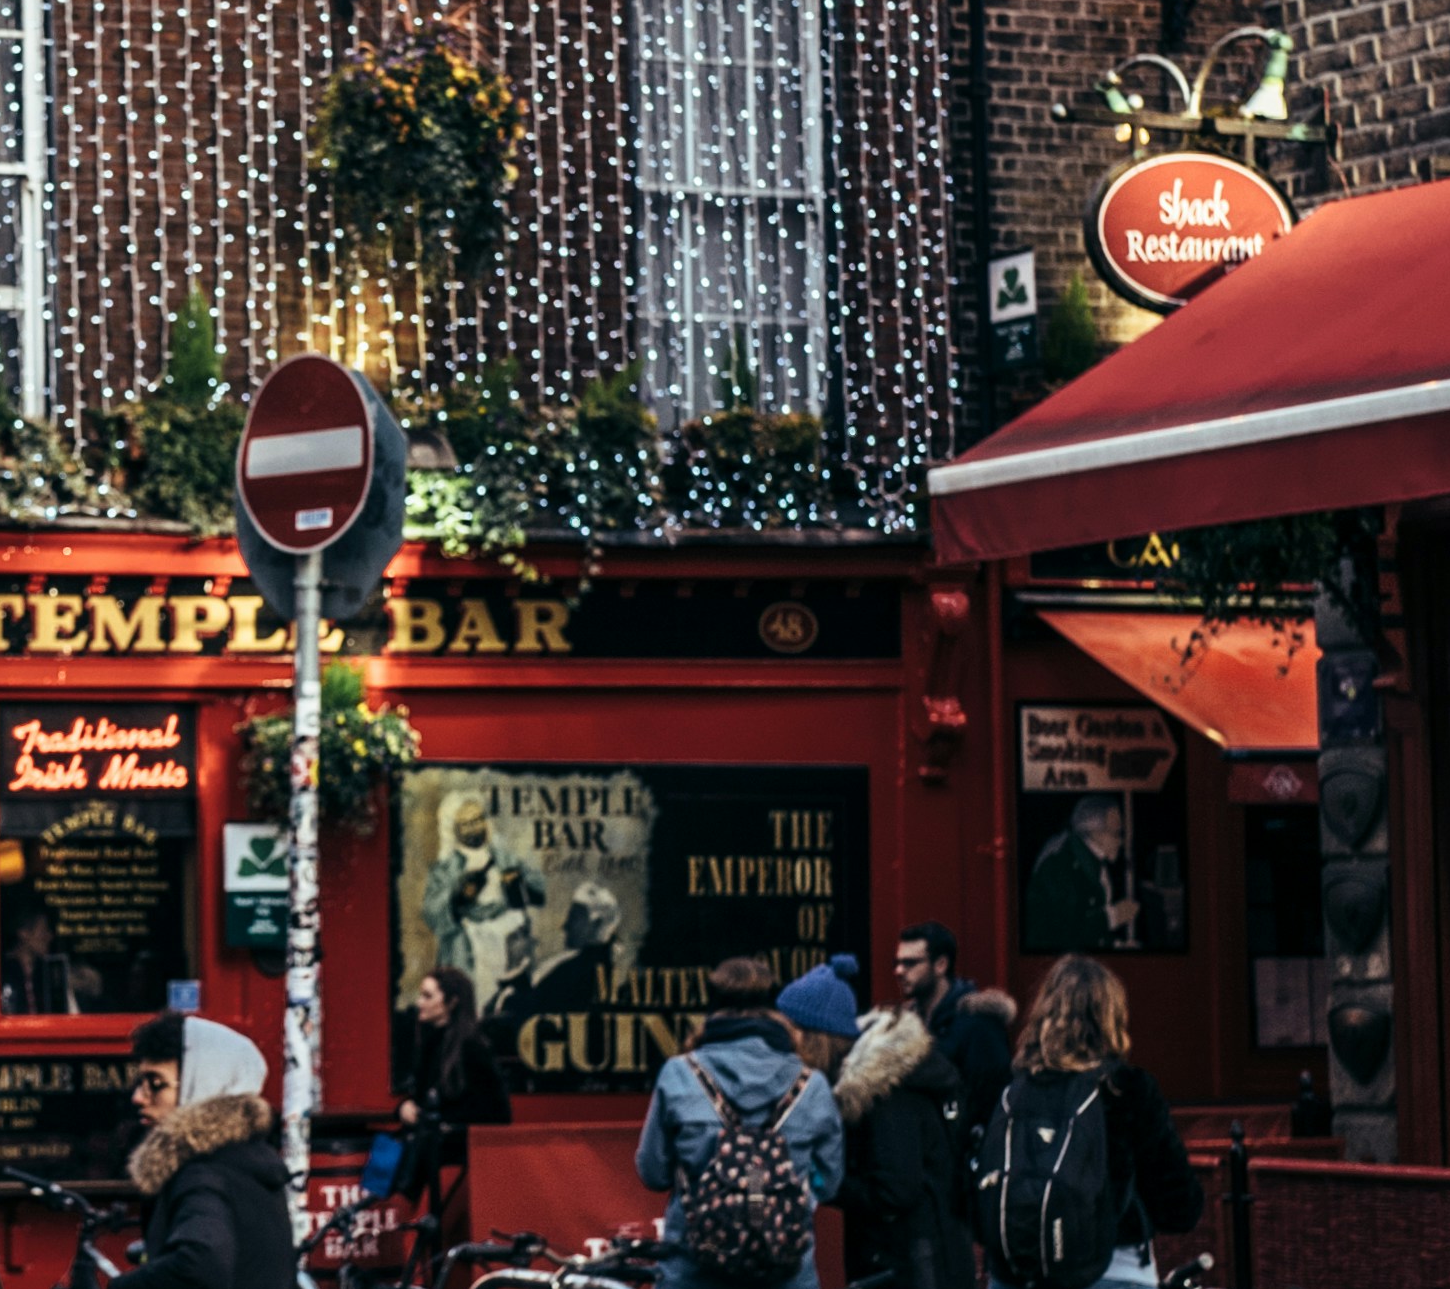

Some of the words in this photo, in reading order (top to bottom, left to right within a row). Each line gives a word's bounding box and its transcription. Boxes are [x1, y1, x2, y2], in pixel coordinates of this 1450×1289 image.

[1124, 227, 1266, 265] Restaurant
[386, 597, 574, 653] BAR
[11, 713, 181, 756] Traditional
[1075, 713, 1146, 737] Garden
[8, 752, 89, 792] Irish
[97, 752, 191, 792] Music
[1027, 739, 1106, 766] Smoking
[482, 784, 649, 819] TEMPLE
[532, 819, 611, 852] BAR
[769, 810, 836, 852] THE
[686, 857, 836, 898] EMPEROR
[797, 904, 834, 943] OF
[517, 1011, 709, 1074] GUIN
